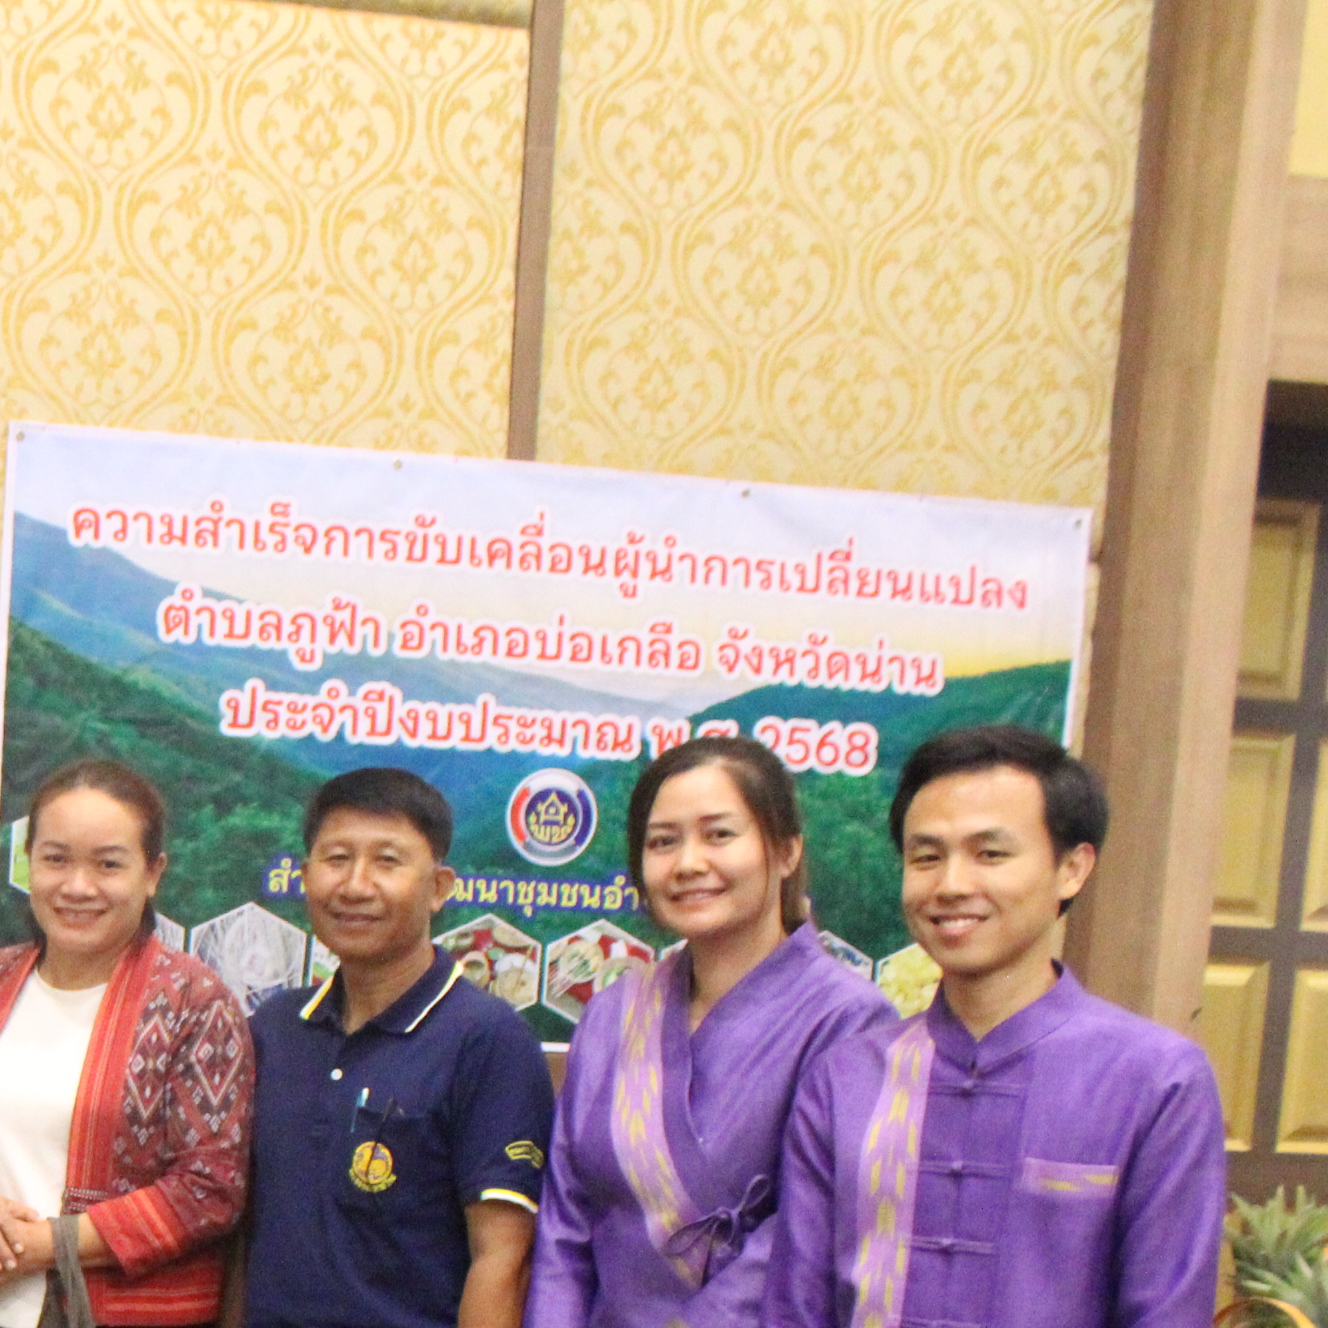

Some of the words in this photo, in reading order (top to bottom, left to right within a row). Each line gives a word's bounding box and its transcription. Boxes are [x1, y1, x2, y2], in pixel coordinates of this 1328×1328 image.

[72, 500, 1029, 610] ความสำเร็จการขับเคลื่อนผู้นำการเปลี่ยนแปลง
[162, 588, 382, 664] ตำบลภูฟ้า
[399, 604, 702, 672] อำเภอบ่อเกลือ
[717, 627, 940, 690] จังหวัดน่าน
[226, 685, 634, 754] ประจำปีงบประมาณ
[759, 724, 871, 769] 2568
